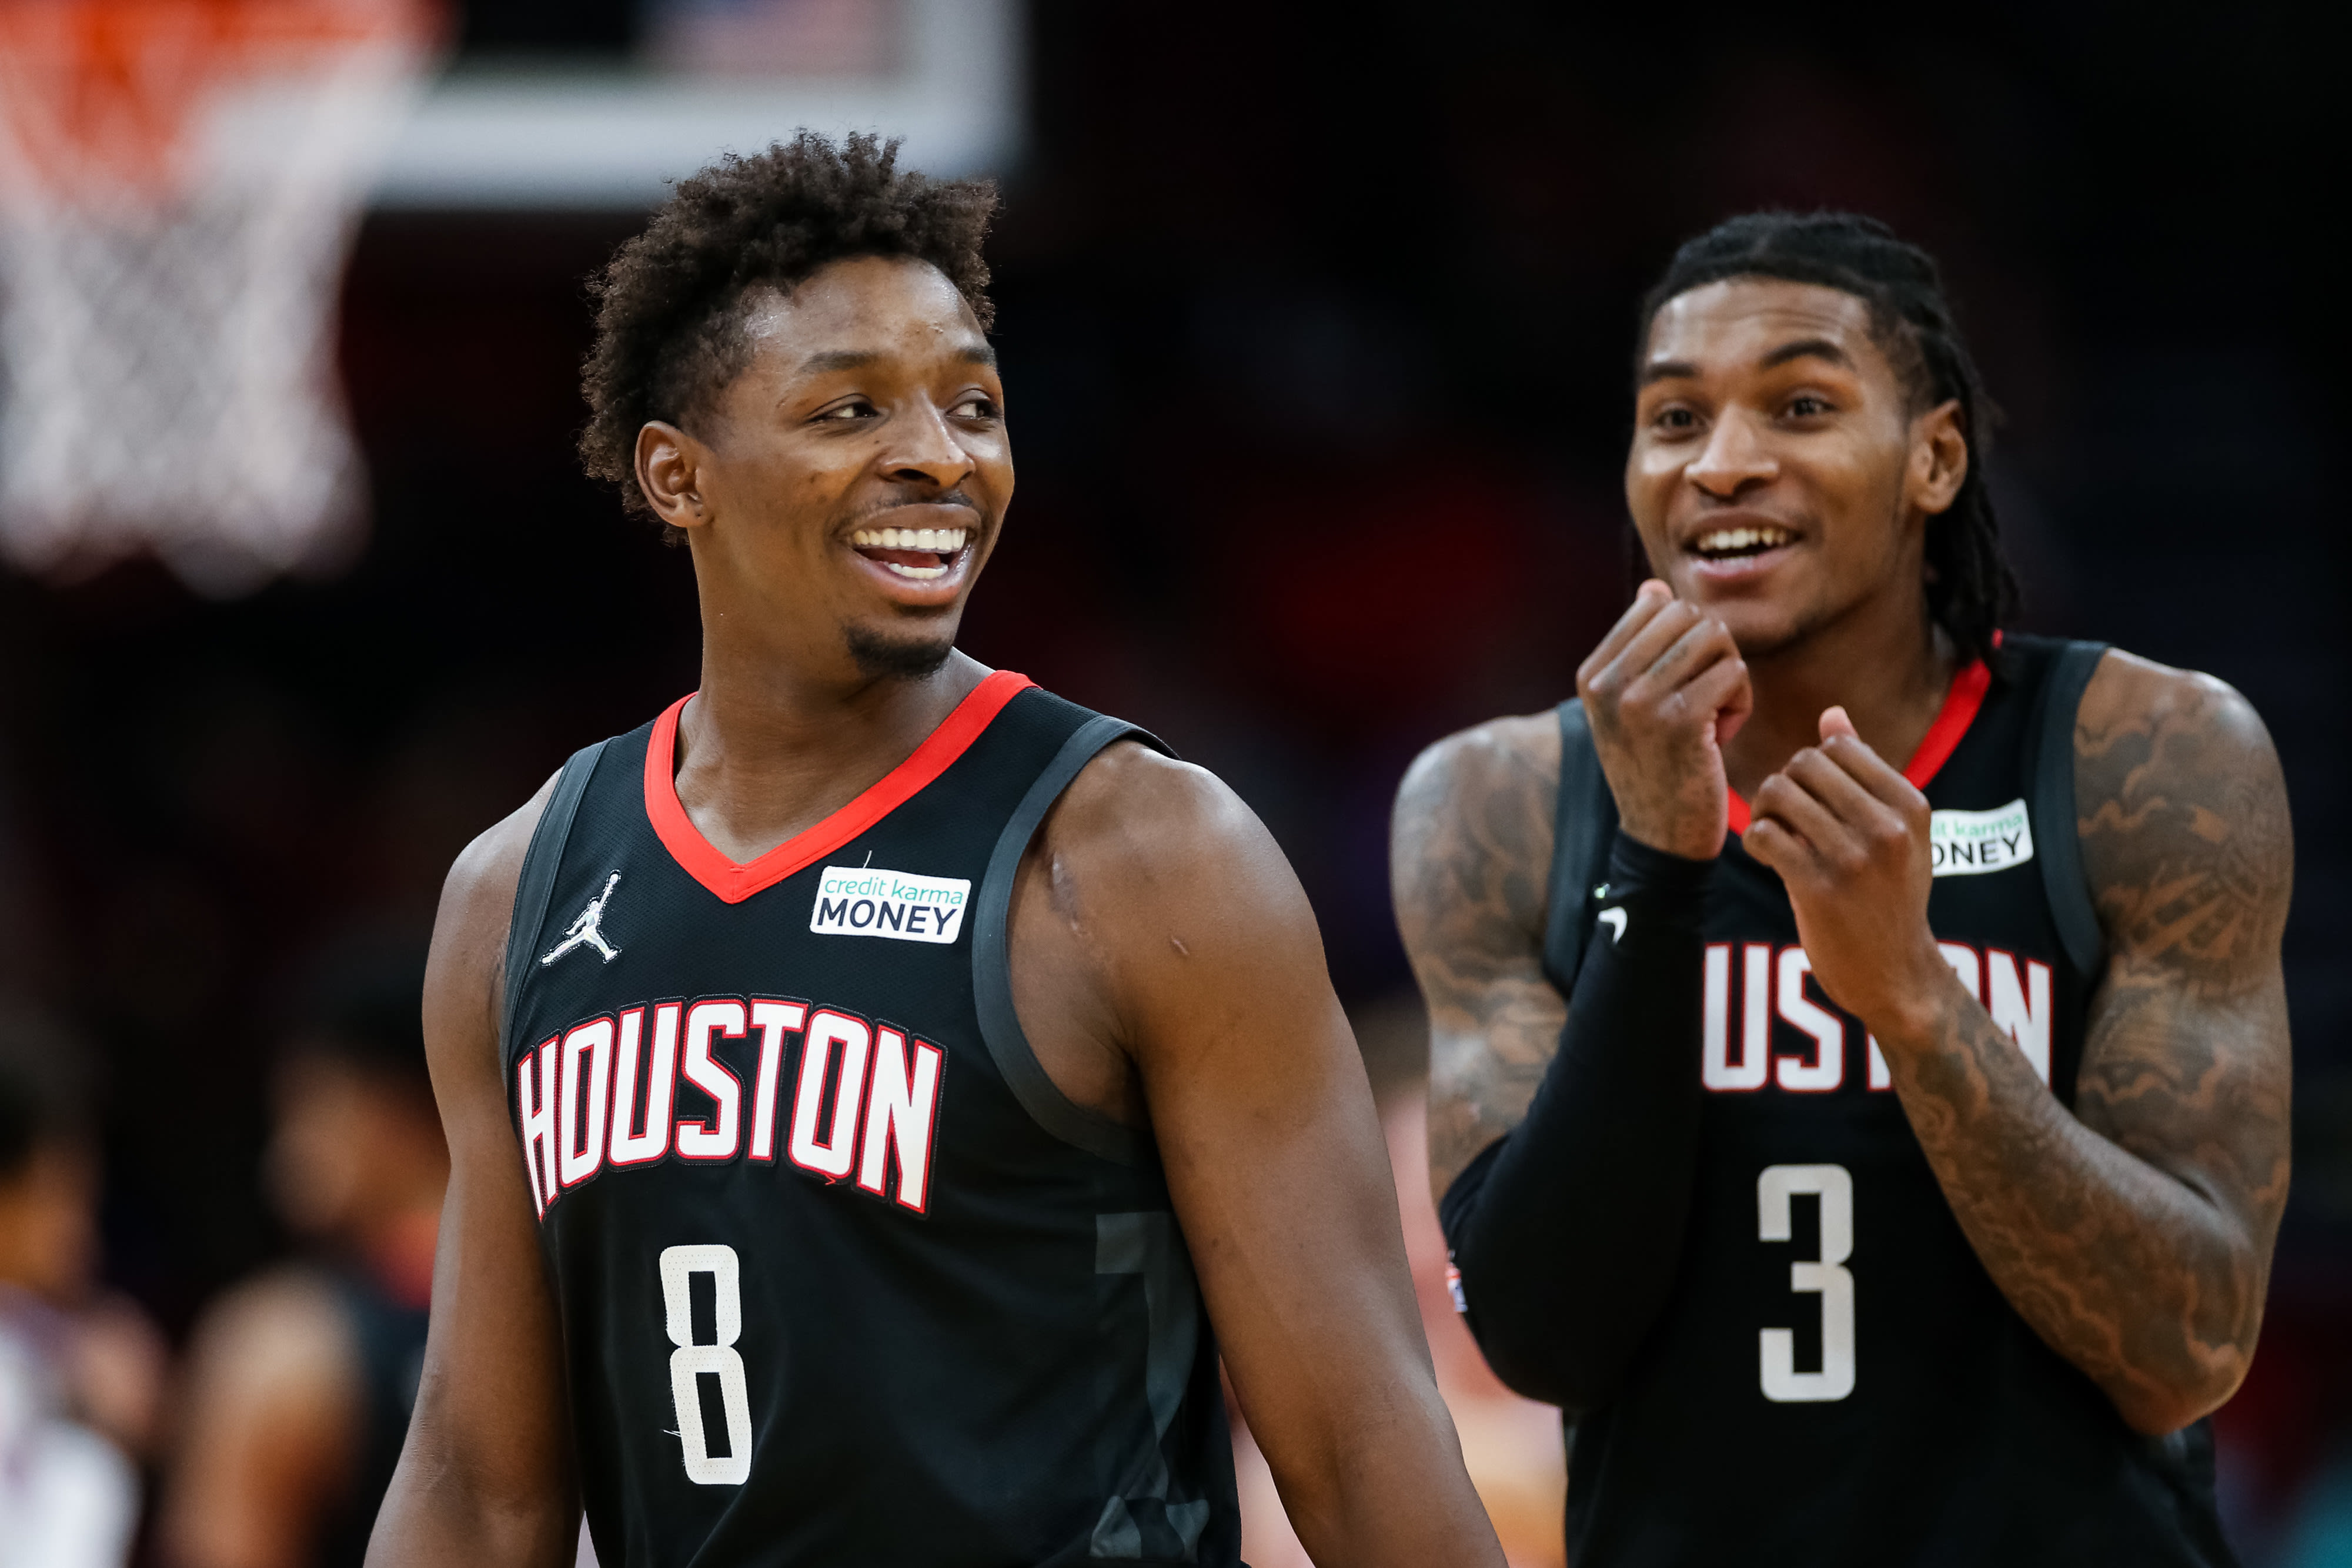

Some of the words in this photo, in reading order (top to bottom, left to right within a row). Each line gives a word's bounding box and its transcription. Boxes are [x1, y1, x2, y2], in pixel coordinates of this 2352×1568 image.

[824, 877, 886, 897] credit
[891, 880, 963, 905] karma
[1932, 831, 2020, 867] ONEY
[817, 897, 958, 935] MONEY
[518, 998, 943, 1222] HOUSTON
[1758, 1164, 1856, 1403] 3
[660, 1245, 752, 1485] 8
